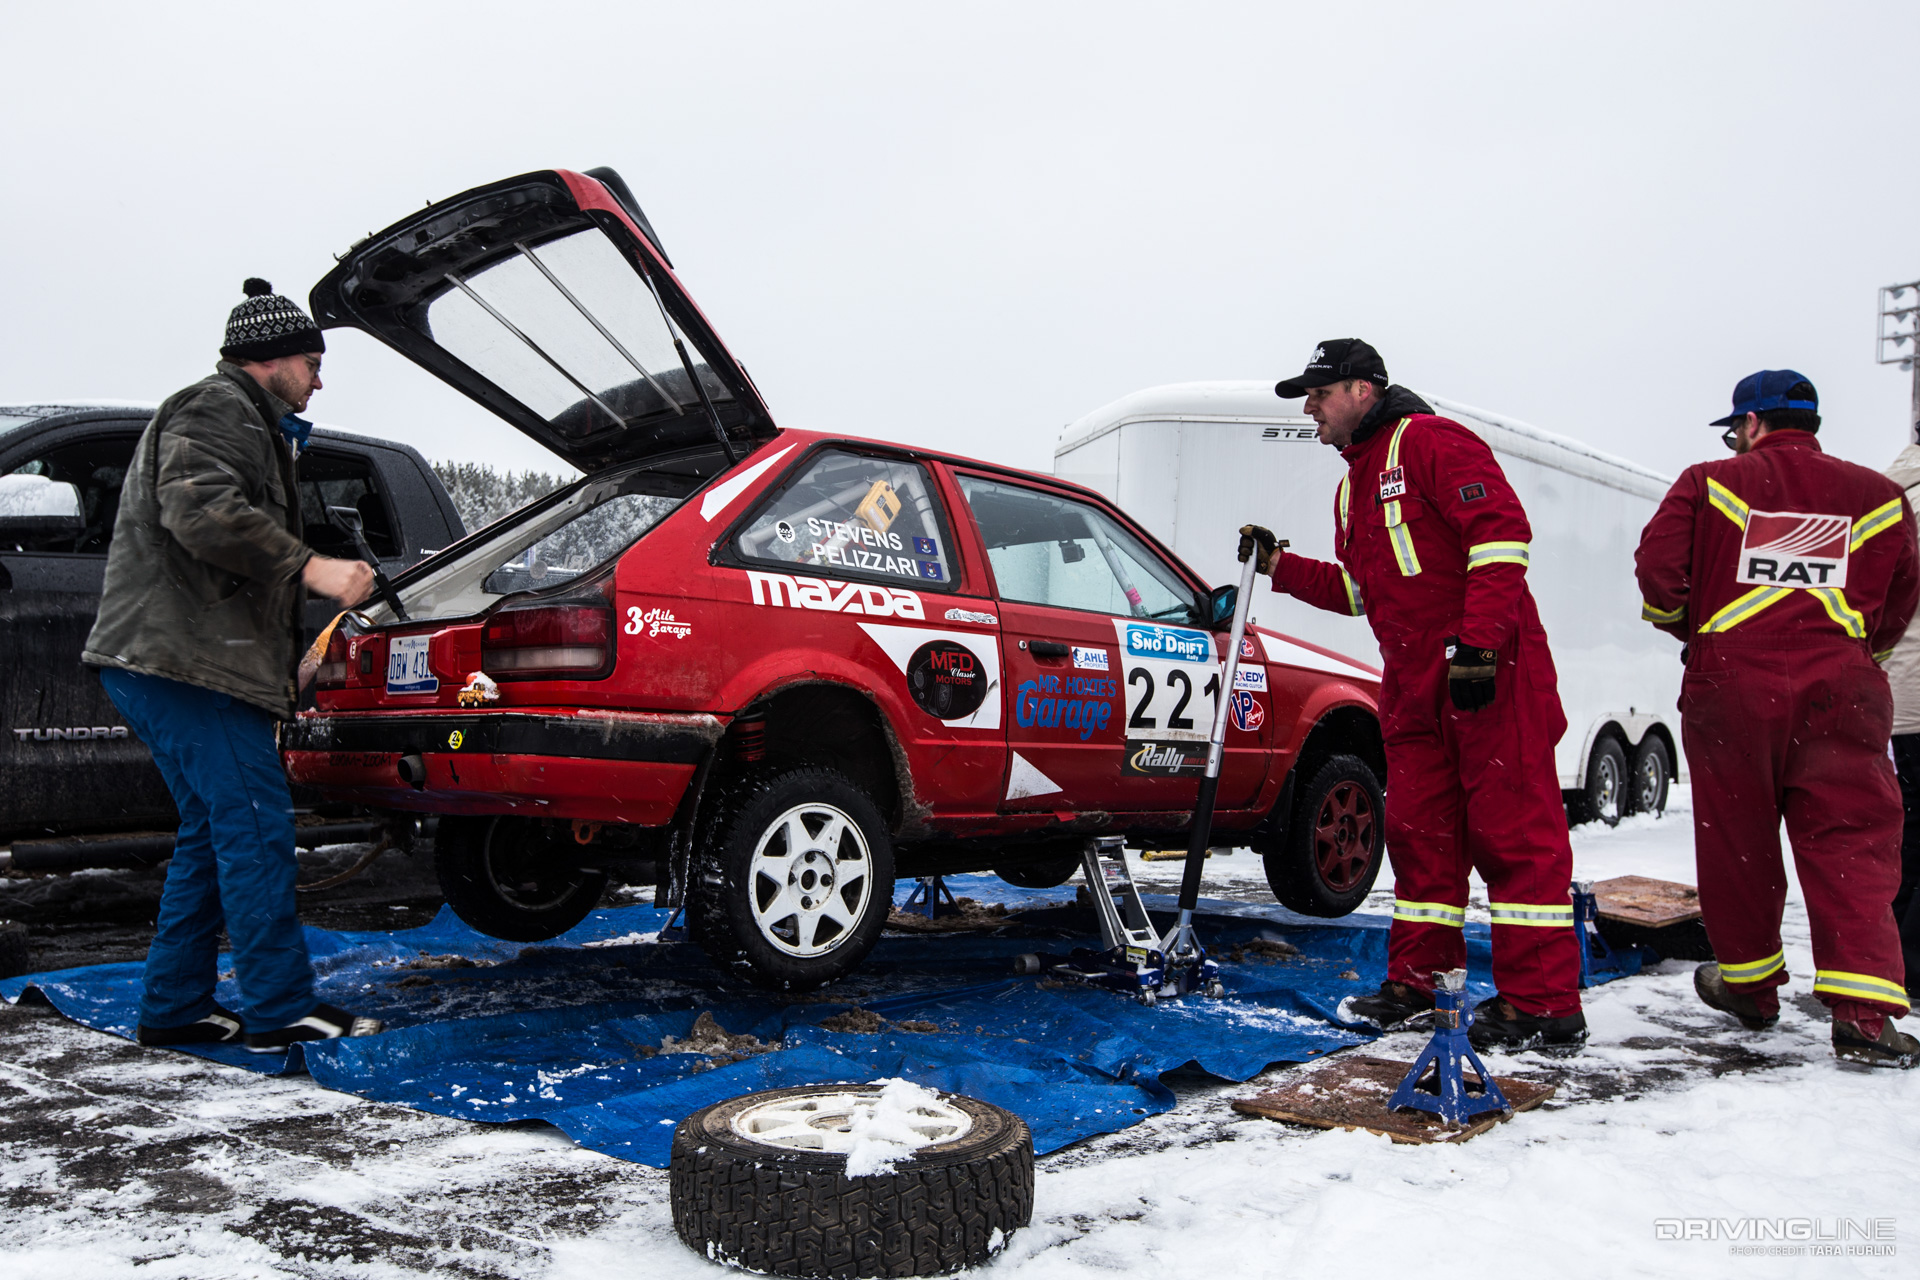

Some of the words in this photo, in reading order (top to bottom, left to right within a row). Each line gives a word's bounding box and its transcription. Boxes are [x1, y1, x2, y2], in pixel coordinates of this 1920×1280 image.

[1381, 484, 1402, 498] RAT
[807, 517, 903, 551] STEVENS
[812, 542, 920, 577] PELIZZARI
[1747, 557, 1836, 585] RAT
[624, 606, 644, 635] 3
[643, 608, 675, 623] Mile
[649, 621, 692, 639] Garage
[1131, 631, 1162, 652] SNO
[1165, 636, 1204, 656] DRIFT
[390, 652, 408, 680] DBW
[412, 651, 435, 679] 431
[1186, 654, 1199, 662] Rally
[950, 667, 976, 679] Classic
[1038, 674, 1061, 694] MR.
[1065, 675, 1117, 698] HOXIE'S
[1235, 670, 1265, 683] EXEDY
[1016, 679, 1112, 741] Garage
[1231, 691, 1253, 731] VP
[13, 726, 129, 741] TUNDRA
[1138, 742, 1185, 773] Rally
